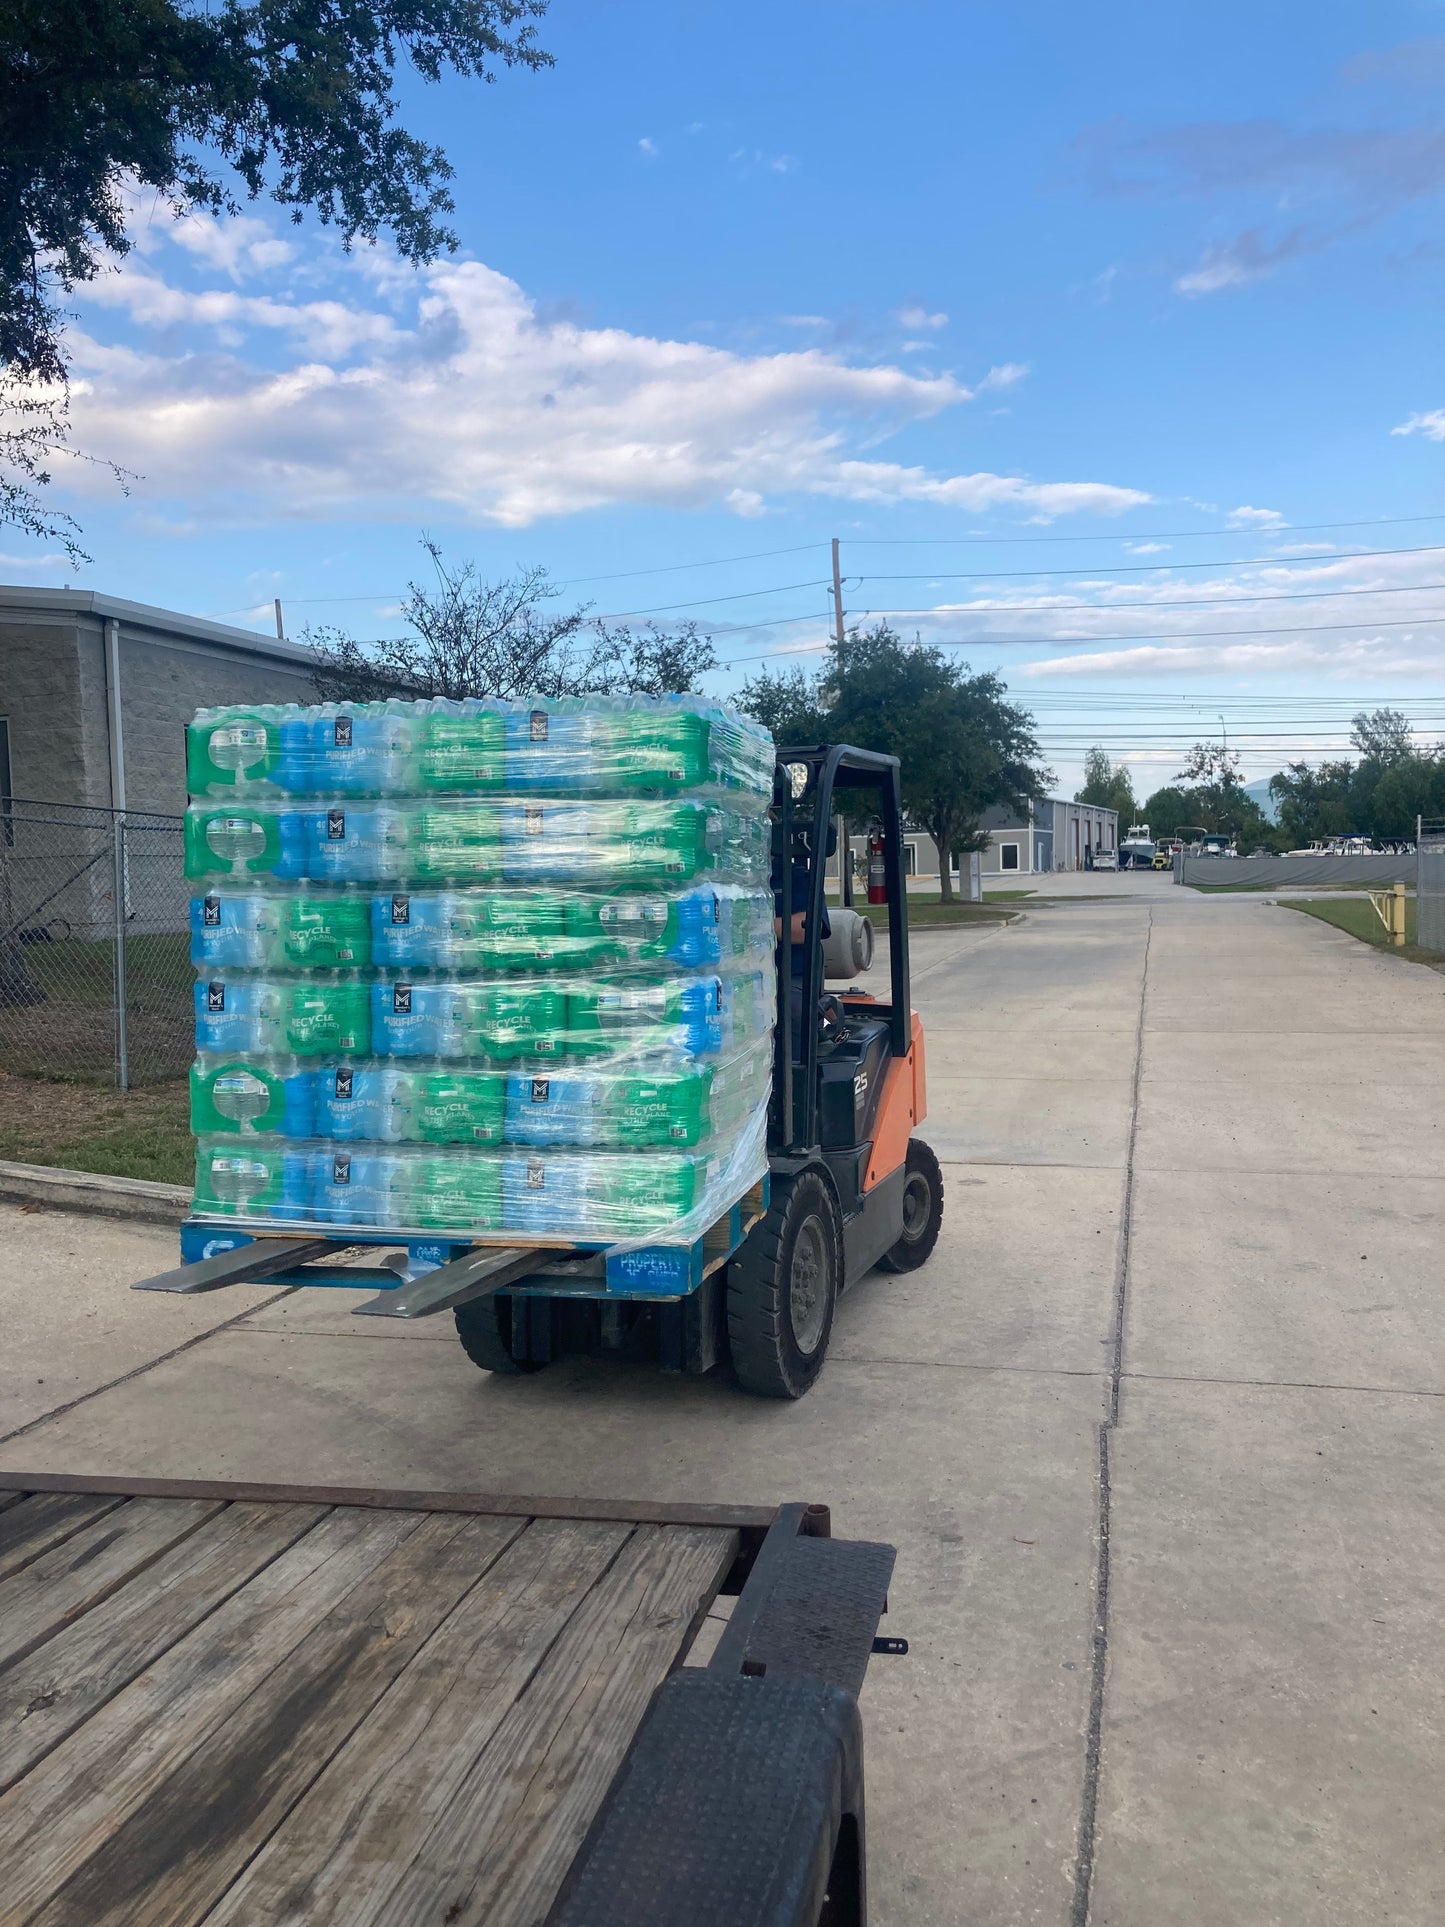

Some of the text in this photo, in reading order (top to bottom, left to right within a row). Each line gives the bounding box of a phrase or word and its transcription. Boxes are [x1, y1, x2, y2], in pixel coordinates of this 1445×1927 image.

[289, 927, 331, 940] RECYCLE
[383, 925, 422, 938] PURIFIED
[484, 926, 528, 938] RECYCLE
[291, 1014, 334, 1027] RECYCLE
[384, 1014, 424, 1027] PURIFIED
[486, 1016, 531, 1029] RECYCLE
[853, 1071, 868, 1095] 25
[327, 1100, 365, 1112] PURIFIED
[425, 1103, 470, 1116] RECYCLE
[624, 1103, 668, 1117] RECYCLE
